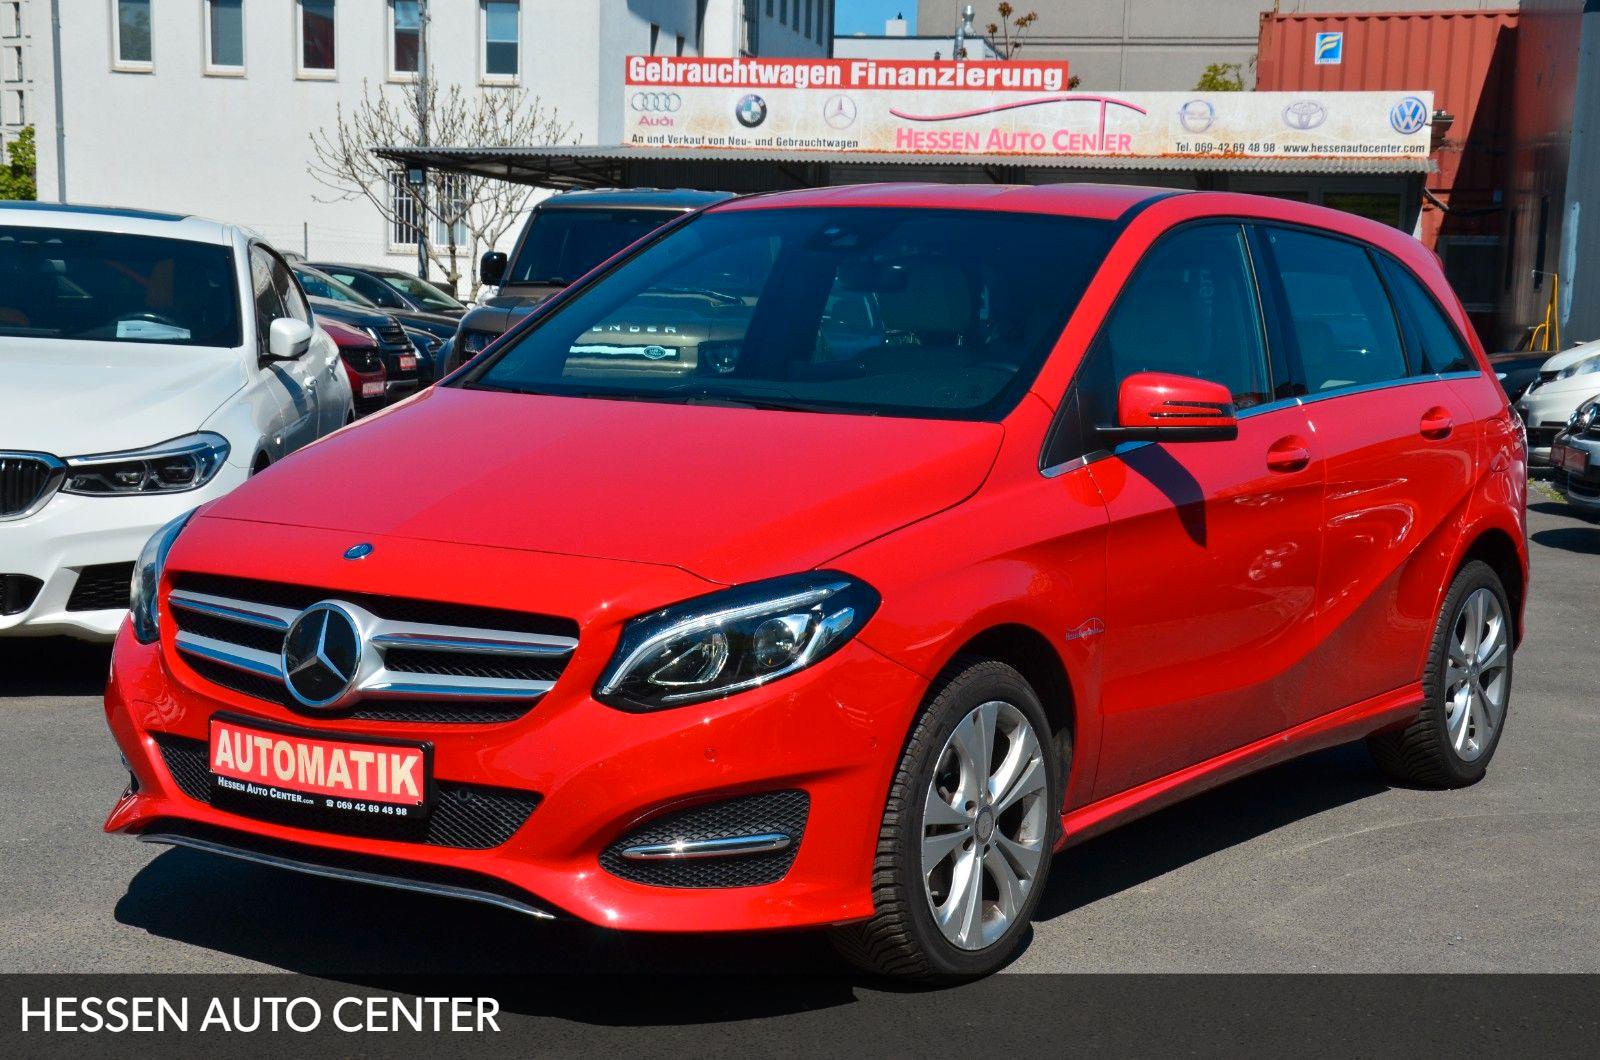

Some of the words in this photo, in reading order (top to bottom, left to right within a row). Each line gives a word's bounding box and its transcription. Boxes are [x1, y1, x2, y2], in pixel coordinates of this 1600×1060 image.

[629, 56, 841, 89] Gebrauchtwagen
[851, 61, 1063, 91] Finanzierung
[638, 115, 674, 127] Audi
[631, 134, 644, 144] An
[647, 134, 665, 145] und
[668, 135, 705, 145] Verkauf
[708, 137, 725, 146] von
[728, 136, 751, 146] Neu-
[755, 137, 773, 147] und
[776, 137, 859, 149] Gebrauchtwagen
[896, 128, 981, 150] HESSEN
[986, 128, 1047, 151] AUTO
[1052, 122, 1132, 151] CENTER
[1175, 142, 1191, 152] Tel.
[1194, 142, 1229, 153] 069-42
[1232, 142, 1245, 153] 69
[1248, 142, 1260, 153] 48
[1263, 142, 1276, 153] 98
[1283, 143, 1425, 154] www.hessenautocenter.com
[215, 729, 420, 797] AUTOMATIK
[217, 776, 246, 792] HESSEN
[246, 783, 268, 798] AUTO
[336, 801, 352, 811] 069
[354, 802, 366, 812] 42
[368, 804, 380, 814] 69
[382, 805, 394, 815] 48
[395, 806, 408, 816] 98
